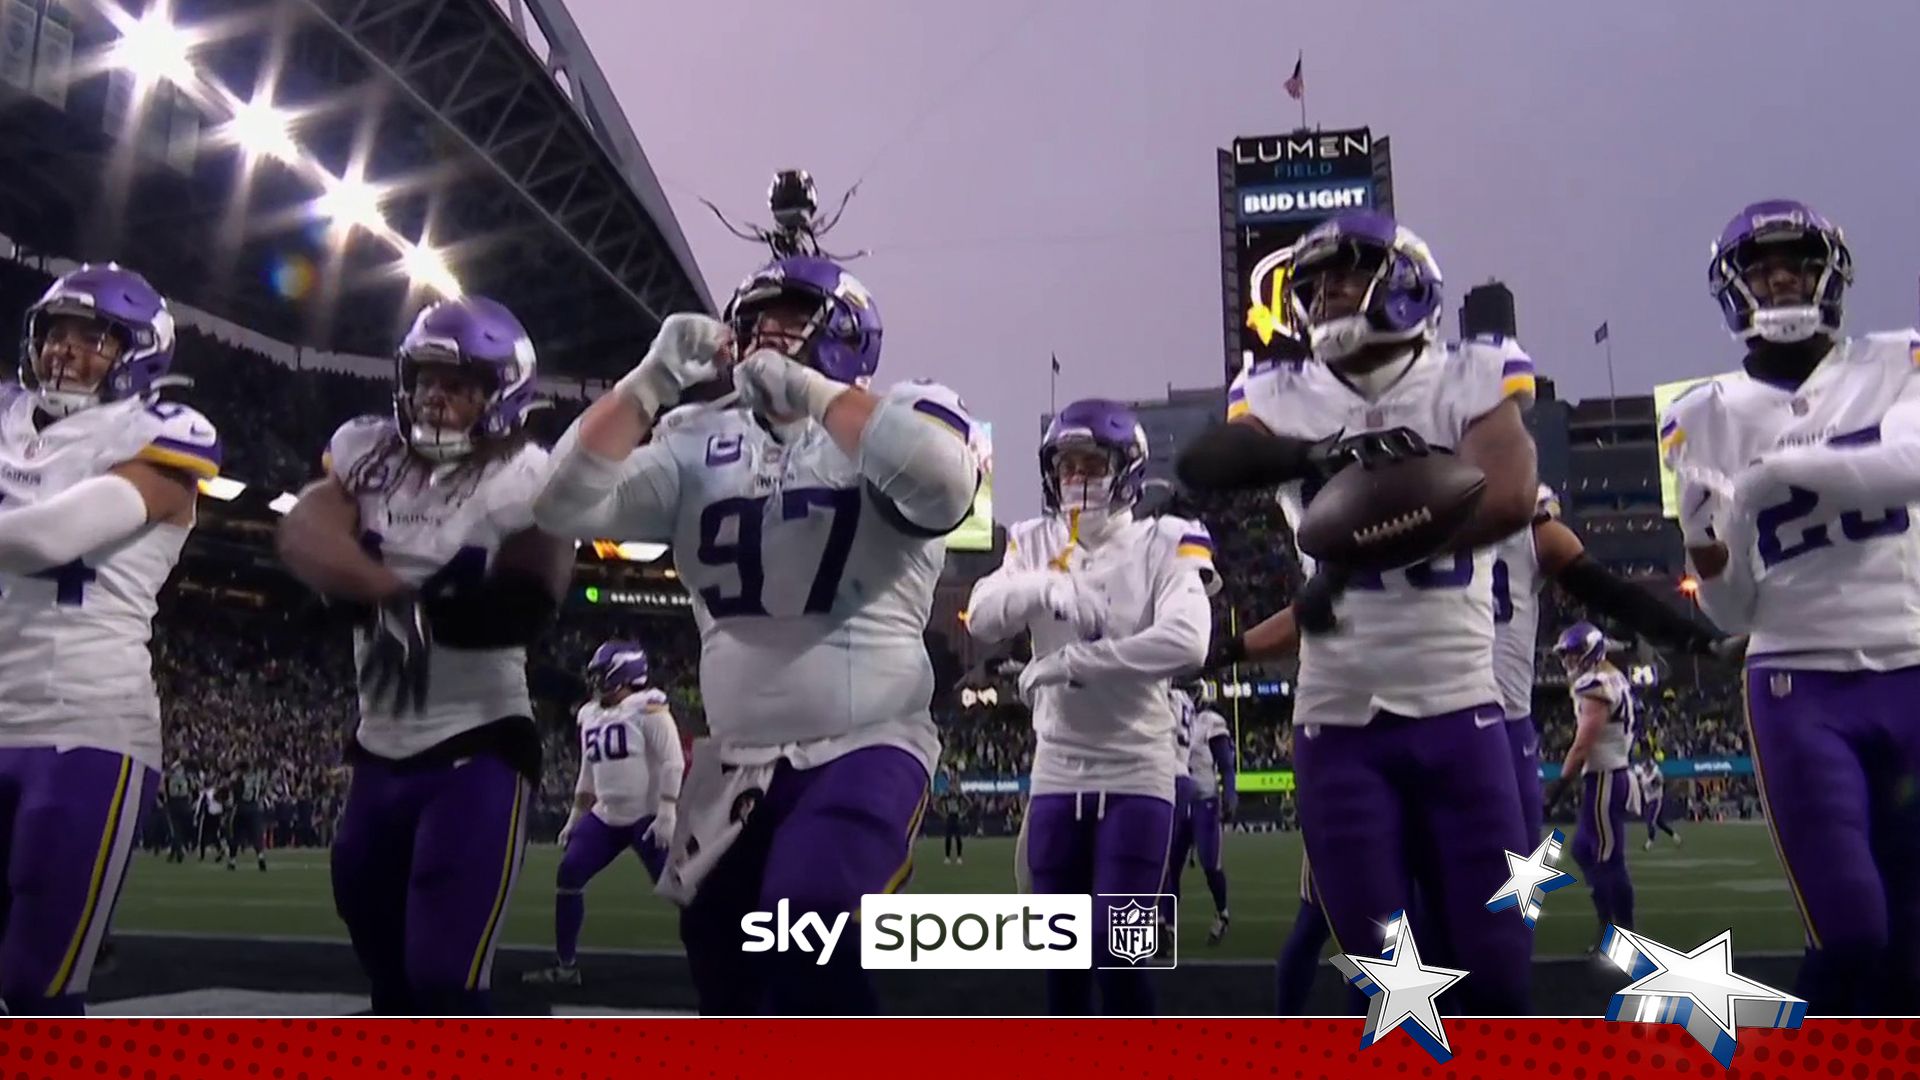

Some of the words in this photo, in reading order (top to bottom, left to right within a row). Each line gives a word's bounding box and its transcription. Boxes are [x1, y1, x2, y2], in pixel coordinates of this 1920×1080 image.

[1235, 134, 1369, 165] LUMEN
[1274, 162, 1333, 178] FIELD
[1244, 194, 1293, 214] BUD
[1296, 187, 1366, 209] LIGHT
[697, 487, 861, 617] 97
[584, 722, 629, 763] 50
